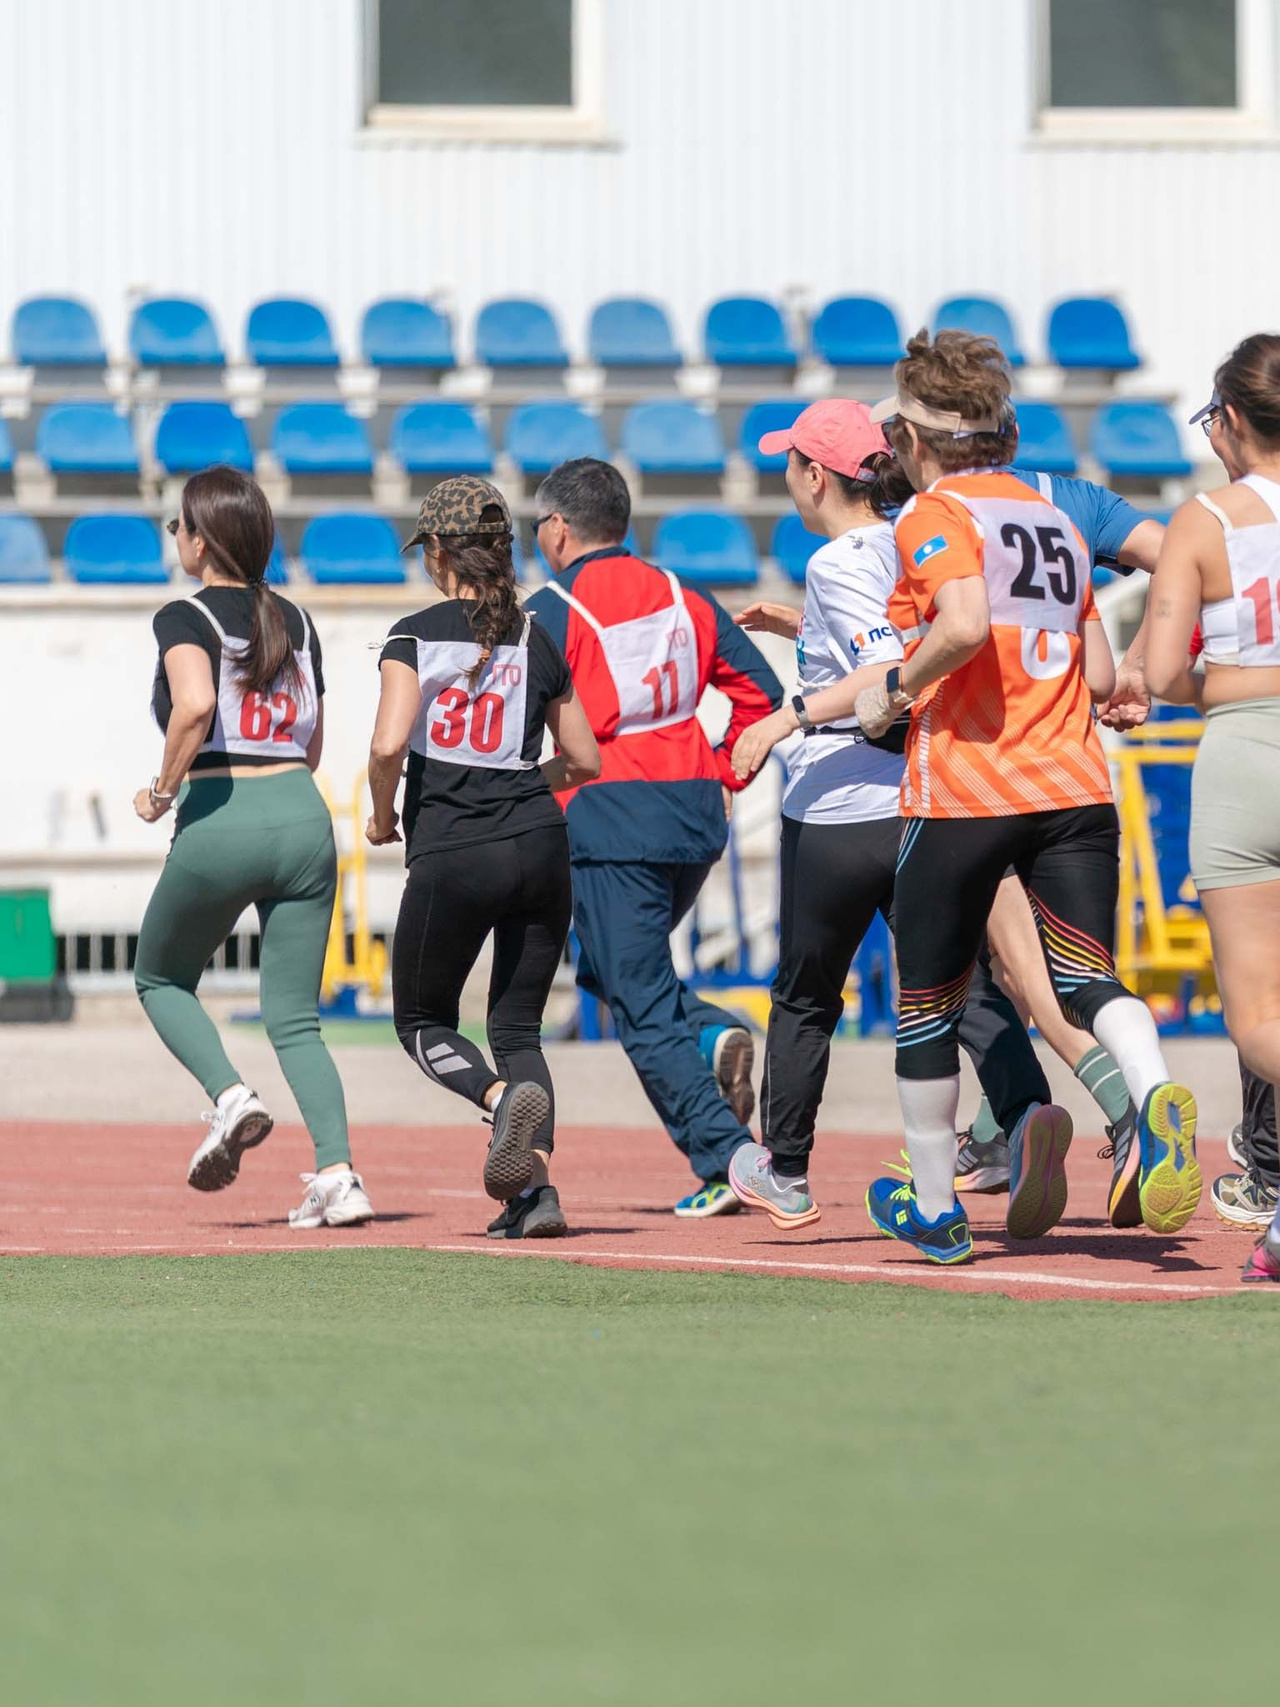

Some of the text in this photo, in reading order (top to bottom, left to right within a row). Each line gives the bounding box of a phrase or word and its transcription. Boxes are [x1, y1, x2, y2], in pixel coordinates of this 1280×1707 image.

[1000, 523, 1077, 606] 25
[492, 663, 522, 688] ГТО
[641, 659, 679, 721] 11
[239, 690, 298, 743] 62
[430, 687, 505, 754] 30
